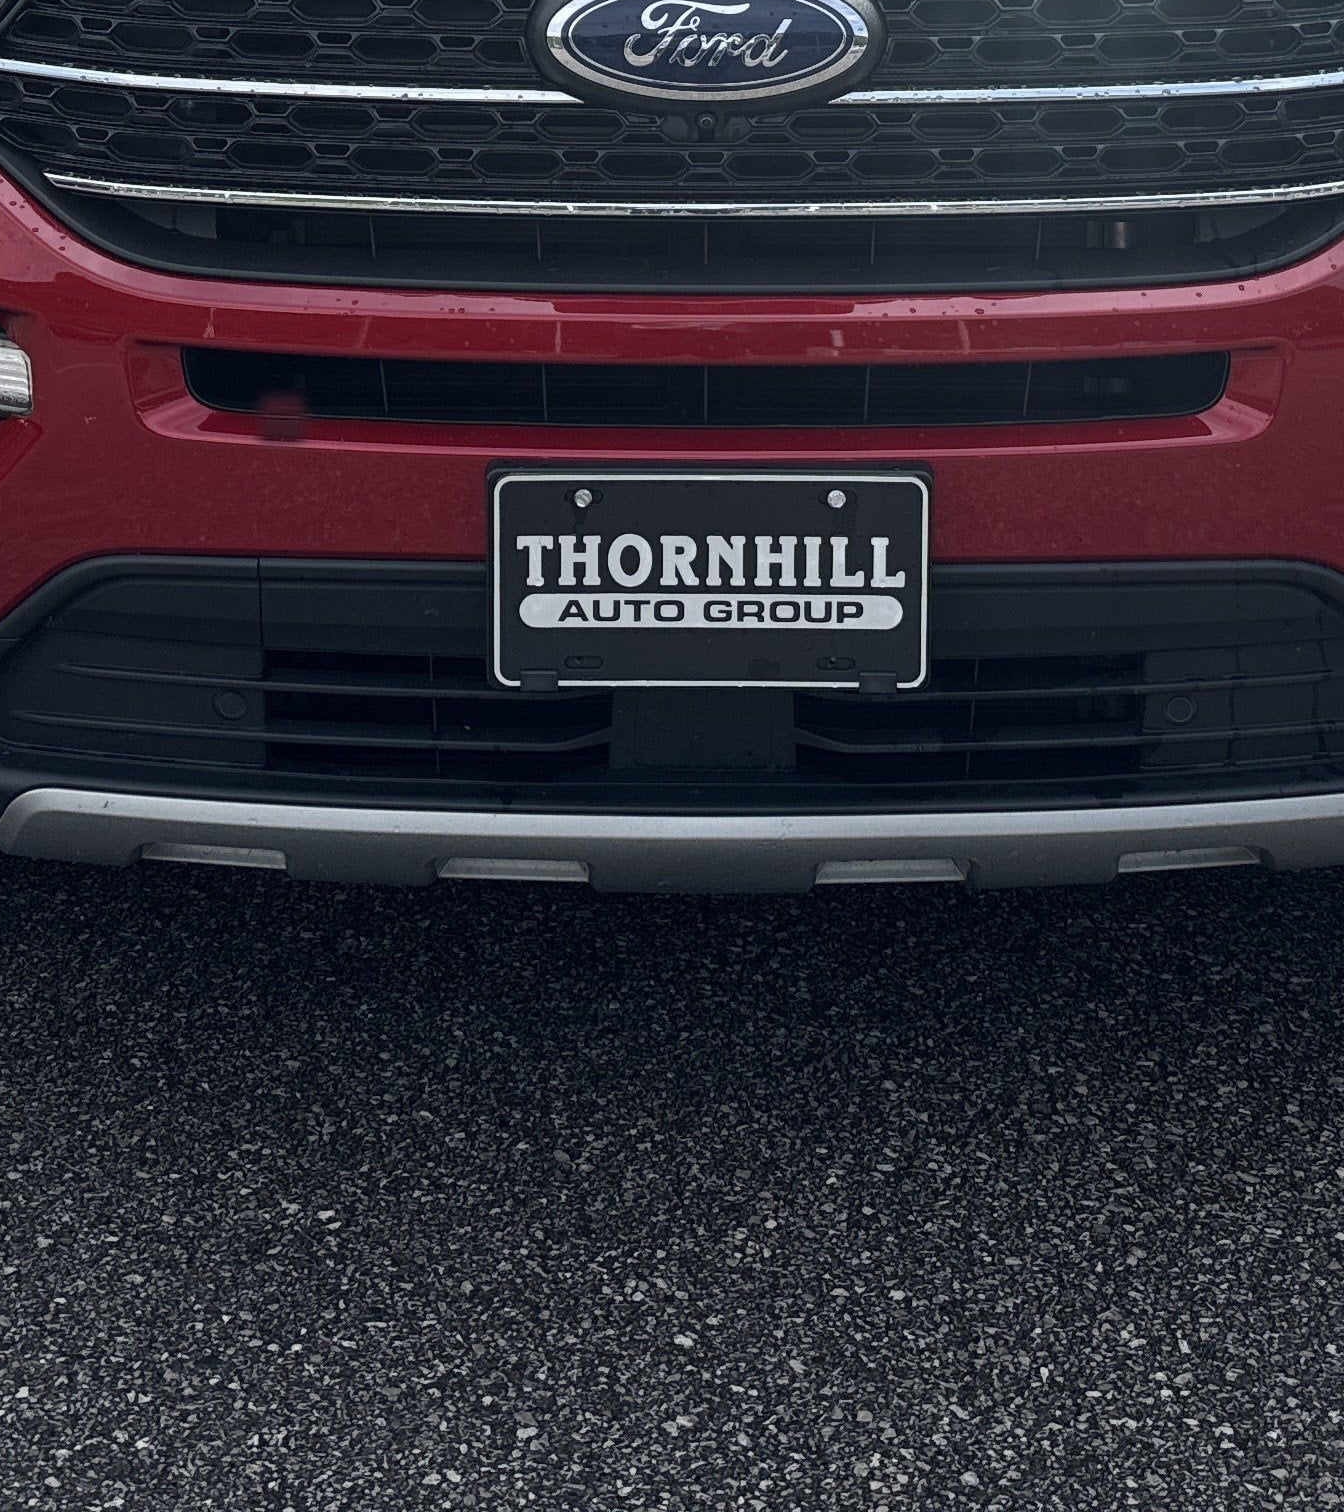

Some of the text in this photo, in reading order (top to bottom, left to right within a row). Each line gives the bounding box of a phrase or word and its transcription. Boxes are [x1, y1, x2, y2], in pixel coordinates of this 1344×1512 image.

[516, 533, 906, 588] THORNHILL
[558, 599, 864, 624] AUTO GROUP
